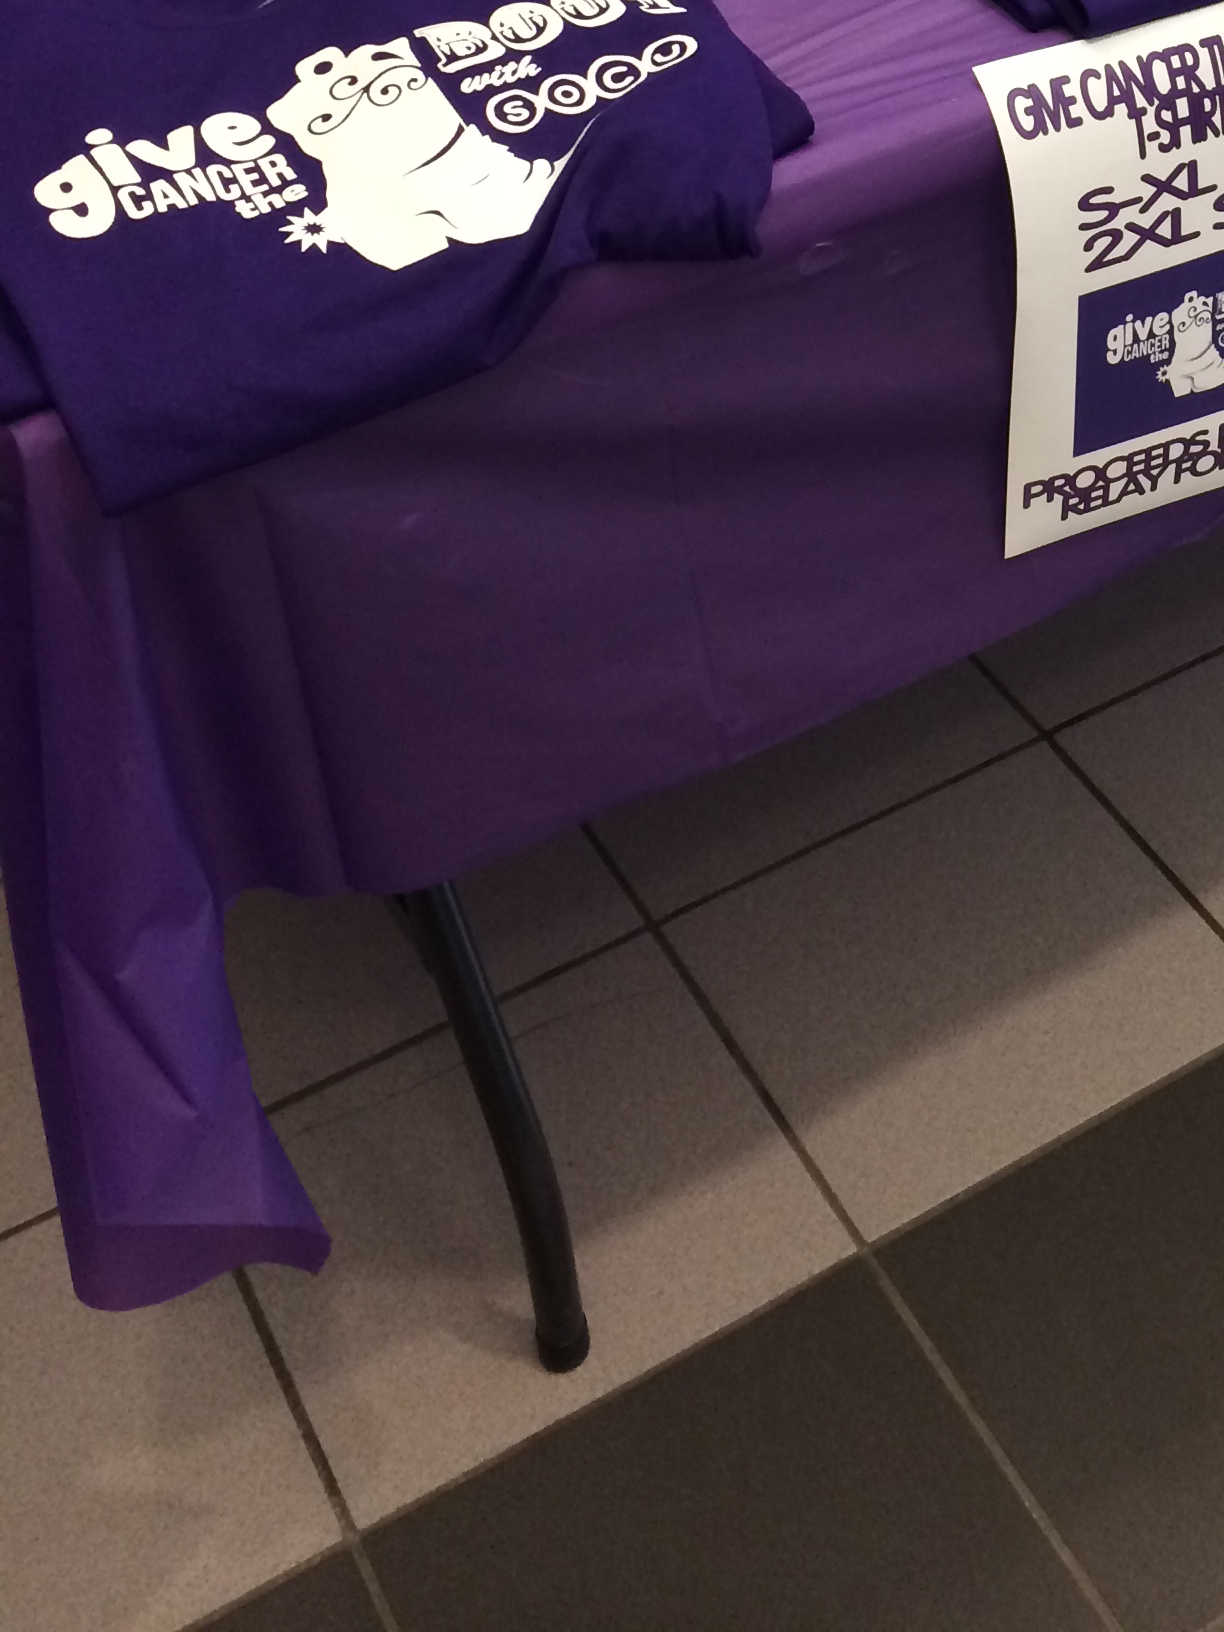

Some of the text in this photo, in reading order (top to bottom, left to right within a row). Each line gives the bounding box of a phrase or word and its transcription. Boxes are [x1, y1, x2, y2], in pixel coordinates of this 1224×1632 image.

[460, 55, 542, 94] with
[486, 33, 698, 133] SOCU
[1006, 74, 1084, 141] GIVE
[1080, 43, 1207, 121] CANCER
[33, 110, 277, 239] give
[115, 153, 298, 220] CANCER
[235, 181, 309, 219] the
[1077, 159, 1218, 232] S-XL
[1083, 206, 1202, 274] 2XL
[1106, 312, 1170, 365] give
[1123, 334, 1170, 362] CANCER
[1150, 350, 1170, 363] the
[1022, 429, 1211, 510] PROCEEDS
[1061, 468, 1175, 521] RELAY
